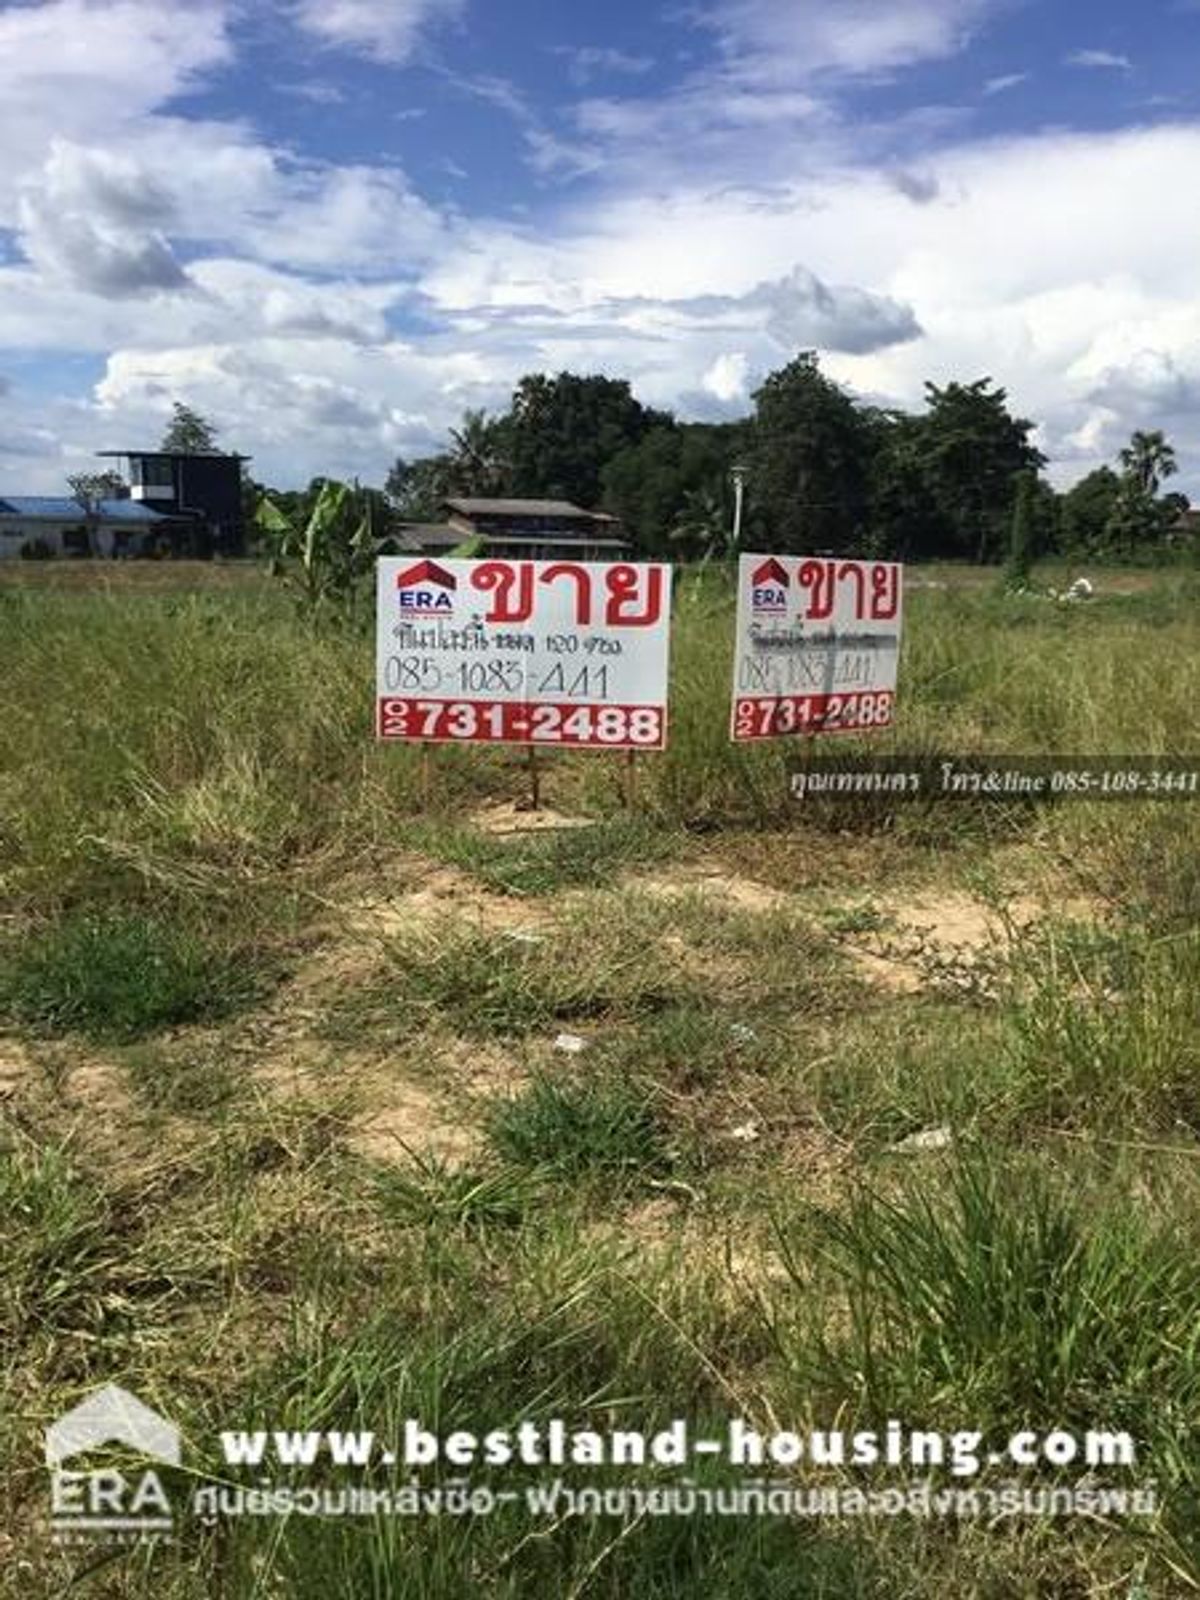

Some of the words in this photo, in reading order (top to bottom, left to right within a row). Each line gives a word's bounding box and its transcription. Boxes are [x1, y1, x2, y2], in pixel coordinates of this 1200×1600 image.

[399, 591, 452, 609] ERA
[470, 561, 663, 627] ขาย
[752, 589, 786, 607] ERA
[798, 560, 898, 620] ขาย
[416, 702, 661, 743] 731-2488
[758, 693, 892, 734] 731-2488
